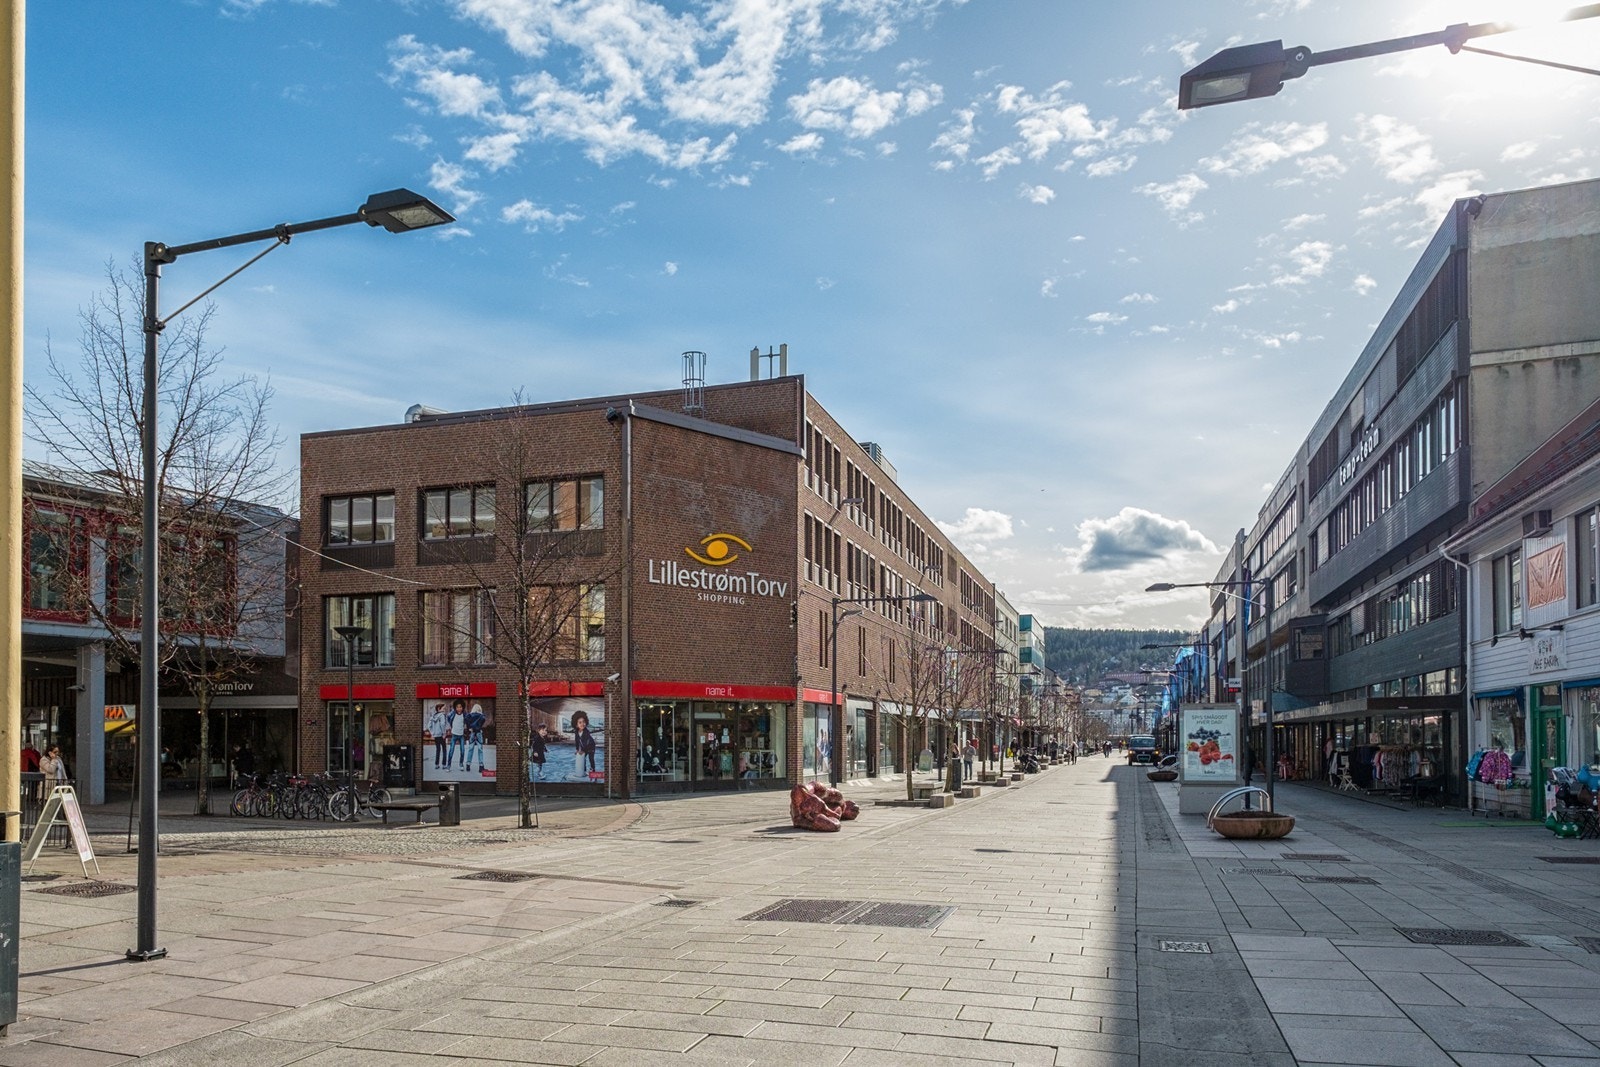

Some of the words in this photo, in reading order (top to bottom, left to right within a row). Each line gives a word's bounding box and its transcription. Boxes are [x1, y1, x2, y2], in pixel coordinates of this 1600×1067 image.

[648, 559, 788, 598] LillestrømTorv
[697, 593, 745, 605] SHOPPING
[705, 687, 726, 696] name
